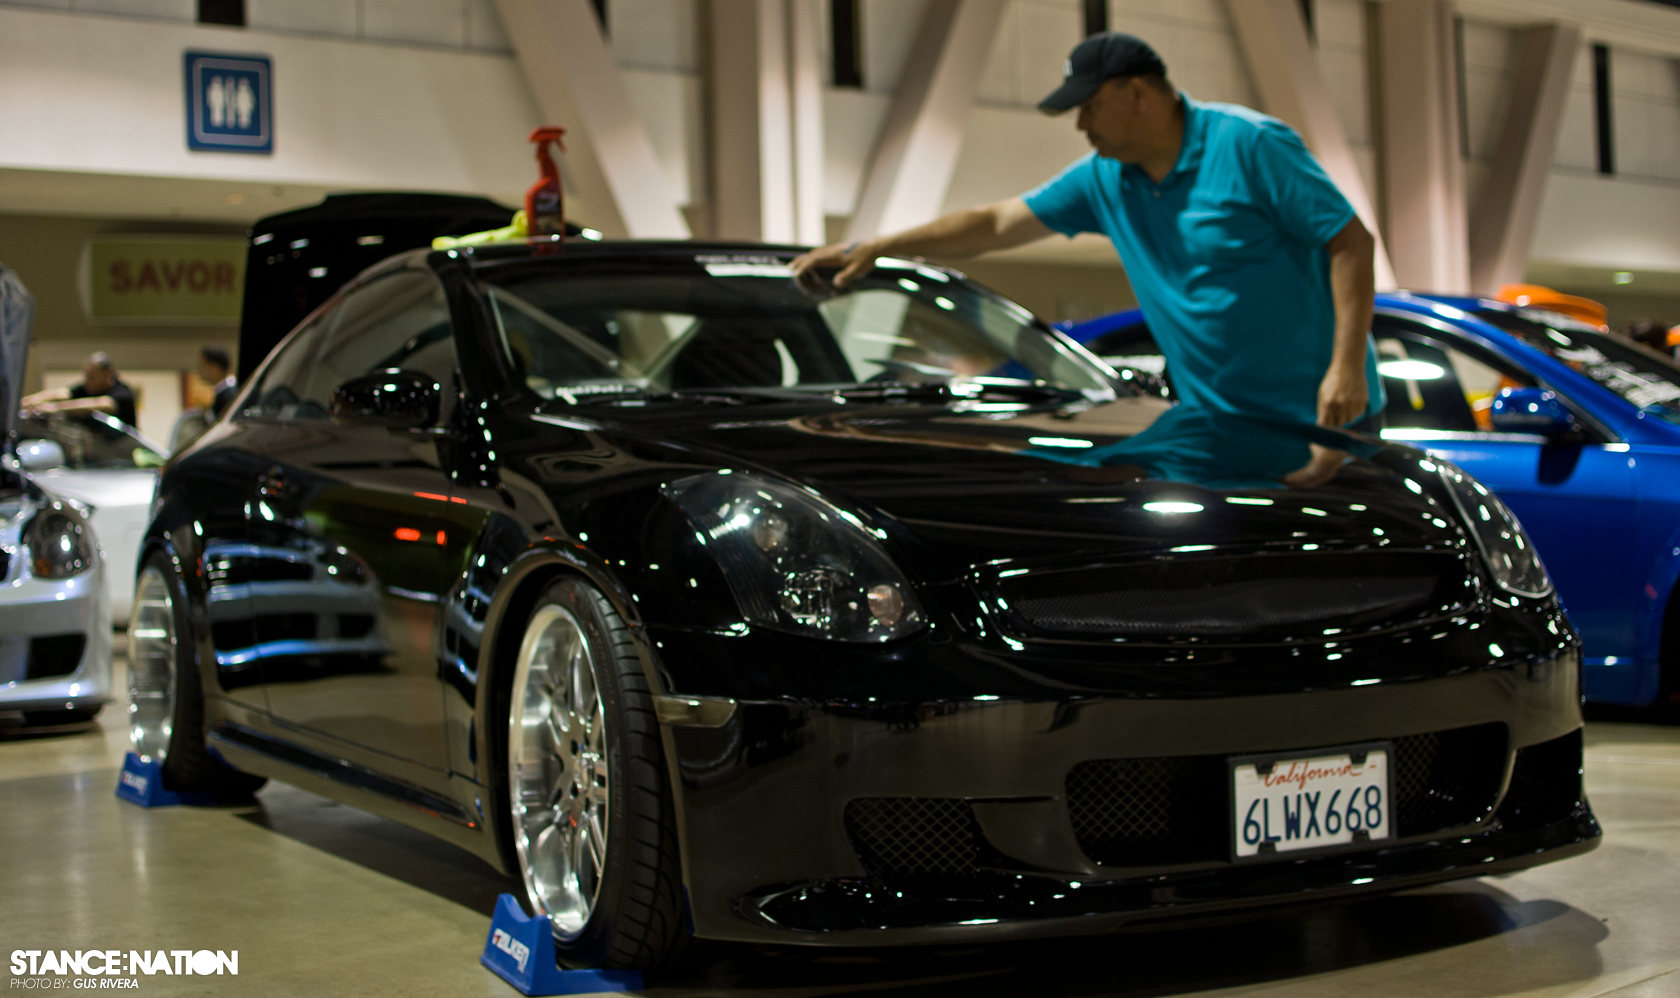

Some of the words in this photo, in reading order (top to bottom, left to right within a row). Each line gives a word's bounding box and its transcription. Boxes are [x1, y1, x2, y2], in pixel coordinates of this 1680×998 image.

[109, 260, 237, 294] SAVOR
[1264, 758, 1363, 790] California
[1243, 785, 1382, 845] 6LWX668
